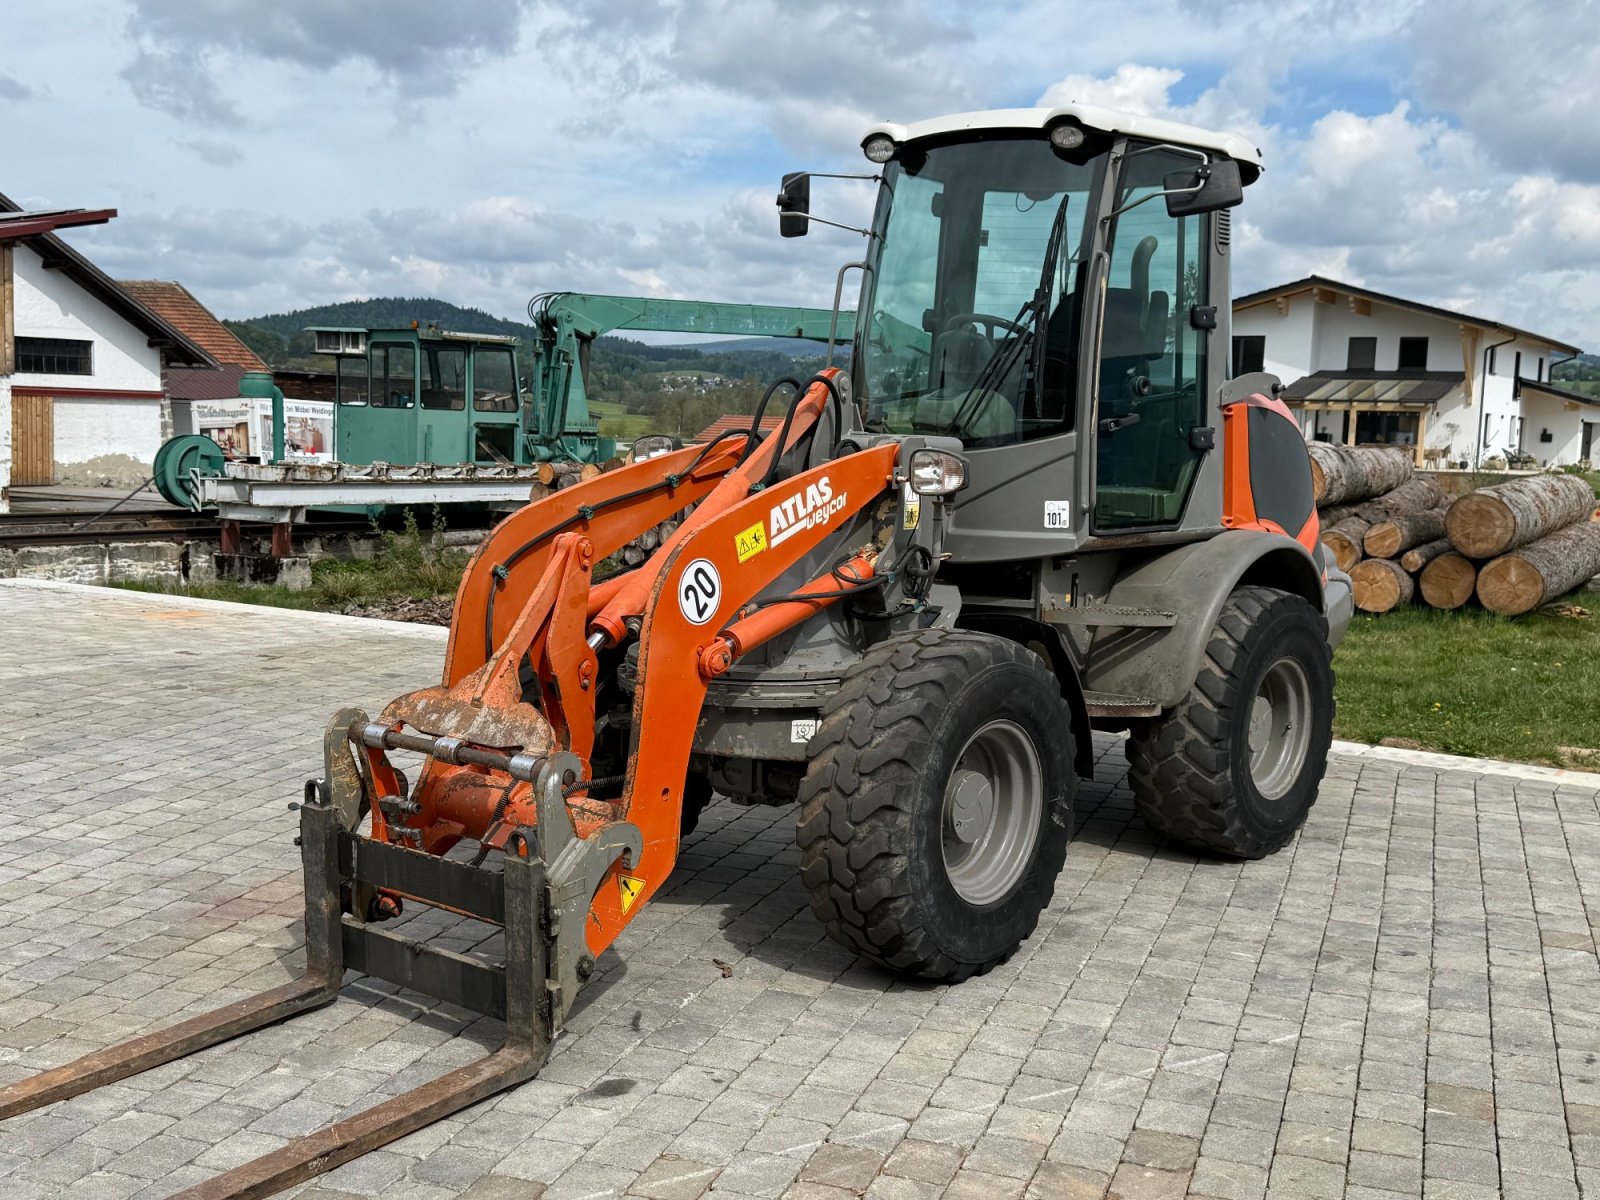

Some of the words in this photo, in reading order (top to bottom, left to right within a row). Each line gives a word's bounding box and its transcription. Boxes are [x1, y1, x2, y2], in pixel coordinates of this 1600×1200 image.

[312, 407, 334, 416] Weidinge
[770, 476, 833, 538] ATLAS
[806, 491, 847, 530] weycor
[1047, 512, 1061, 526] 101
[684, 567, 716, 619] 20
